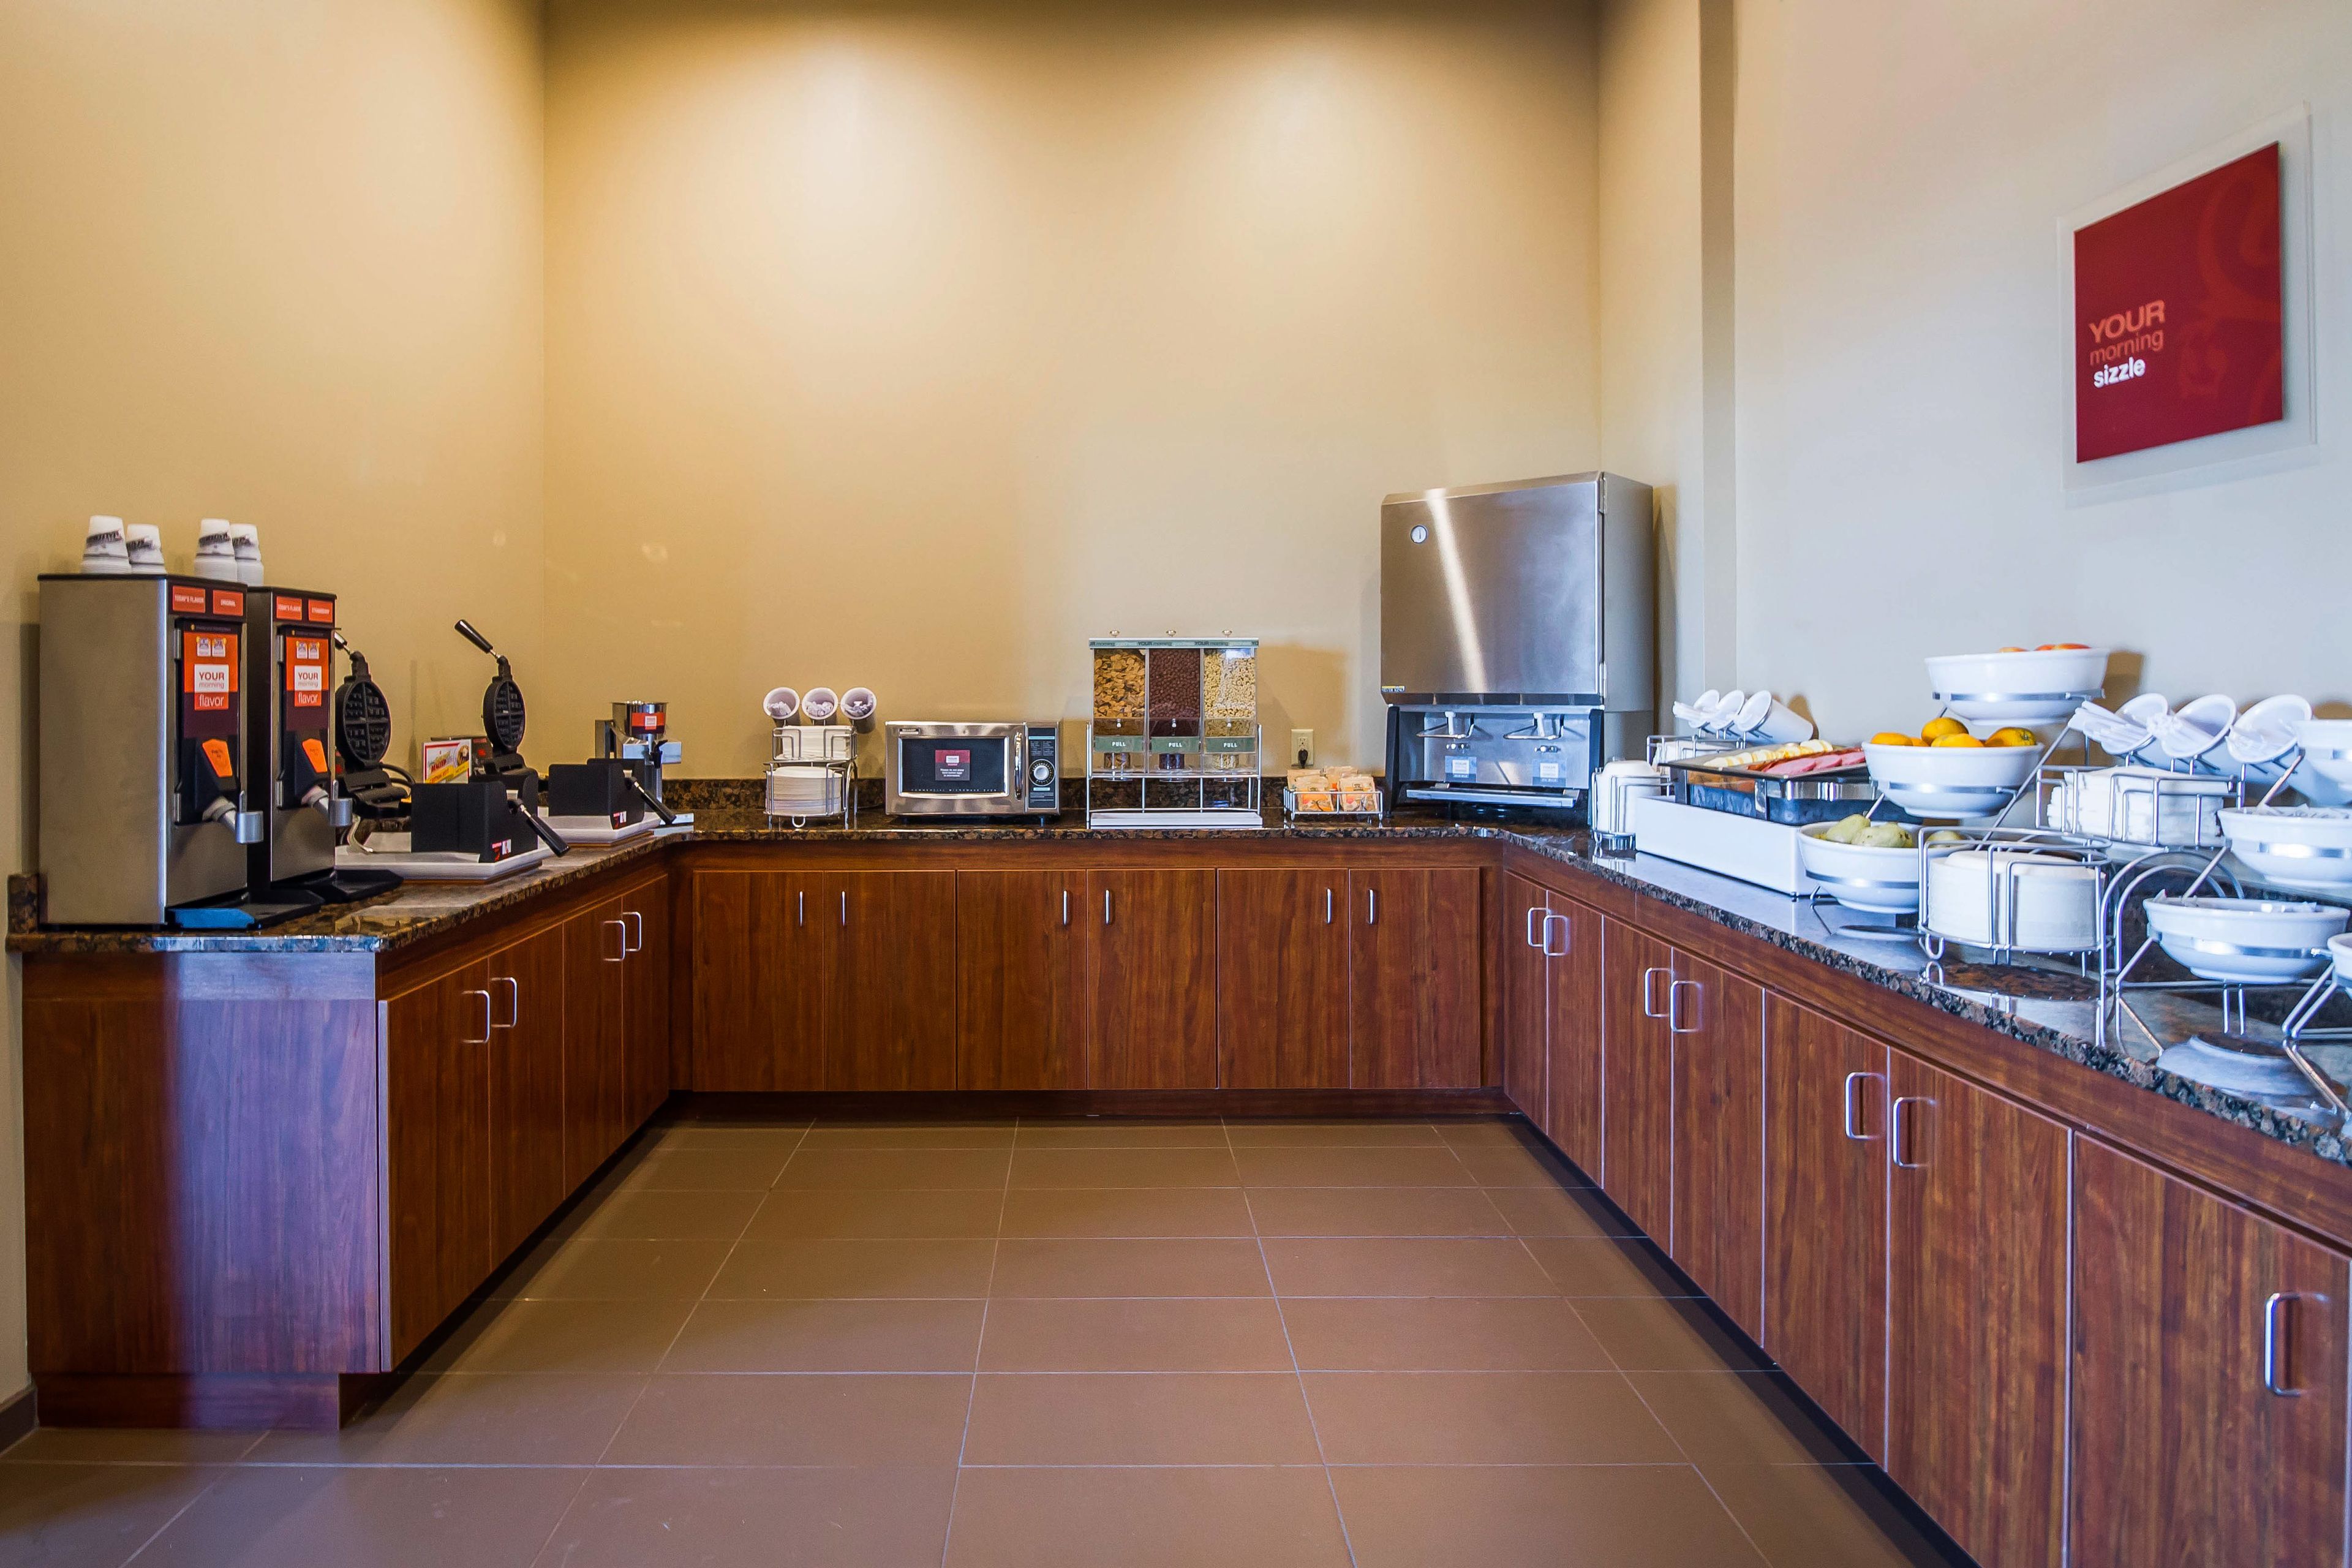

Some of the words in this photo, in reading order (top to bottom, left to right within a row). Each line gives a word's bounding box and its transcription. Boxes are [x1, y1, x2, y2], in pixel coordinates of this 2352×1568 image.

[2088, 300, 2165, 343] YOUR
[2089, 330, 2164, 366] morning
[2094, 356, 2146, 388] sizzle
[199, 672, 225, 680] YOUR
[198, 681, 225, 690] morning
[199, 695, 224, 707] flavor
[298, 692, 318, 704] flavor
